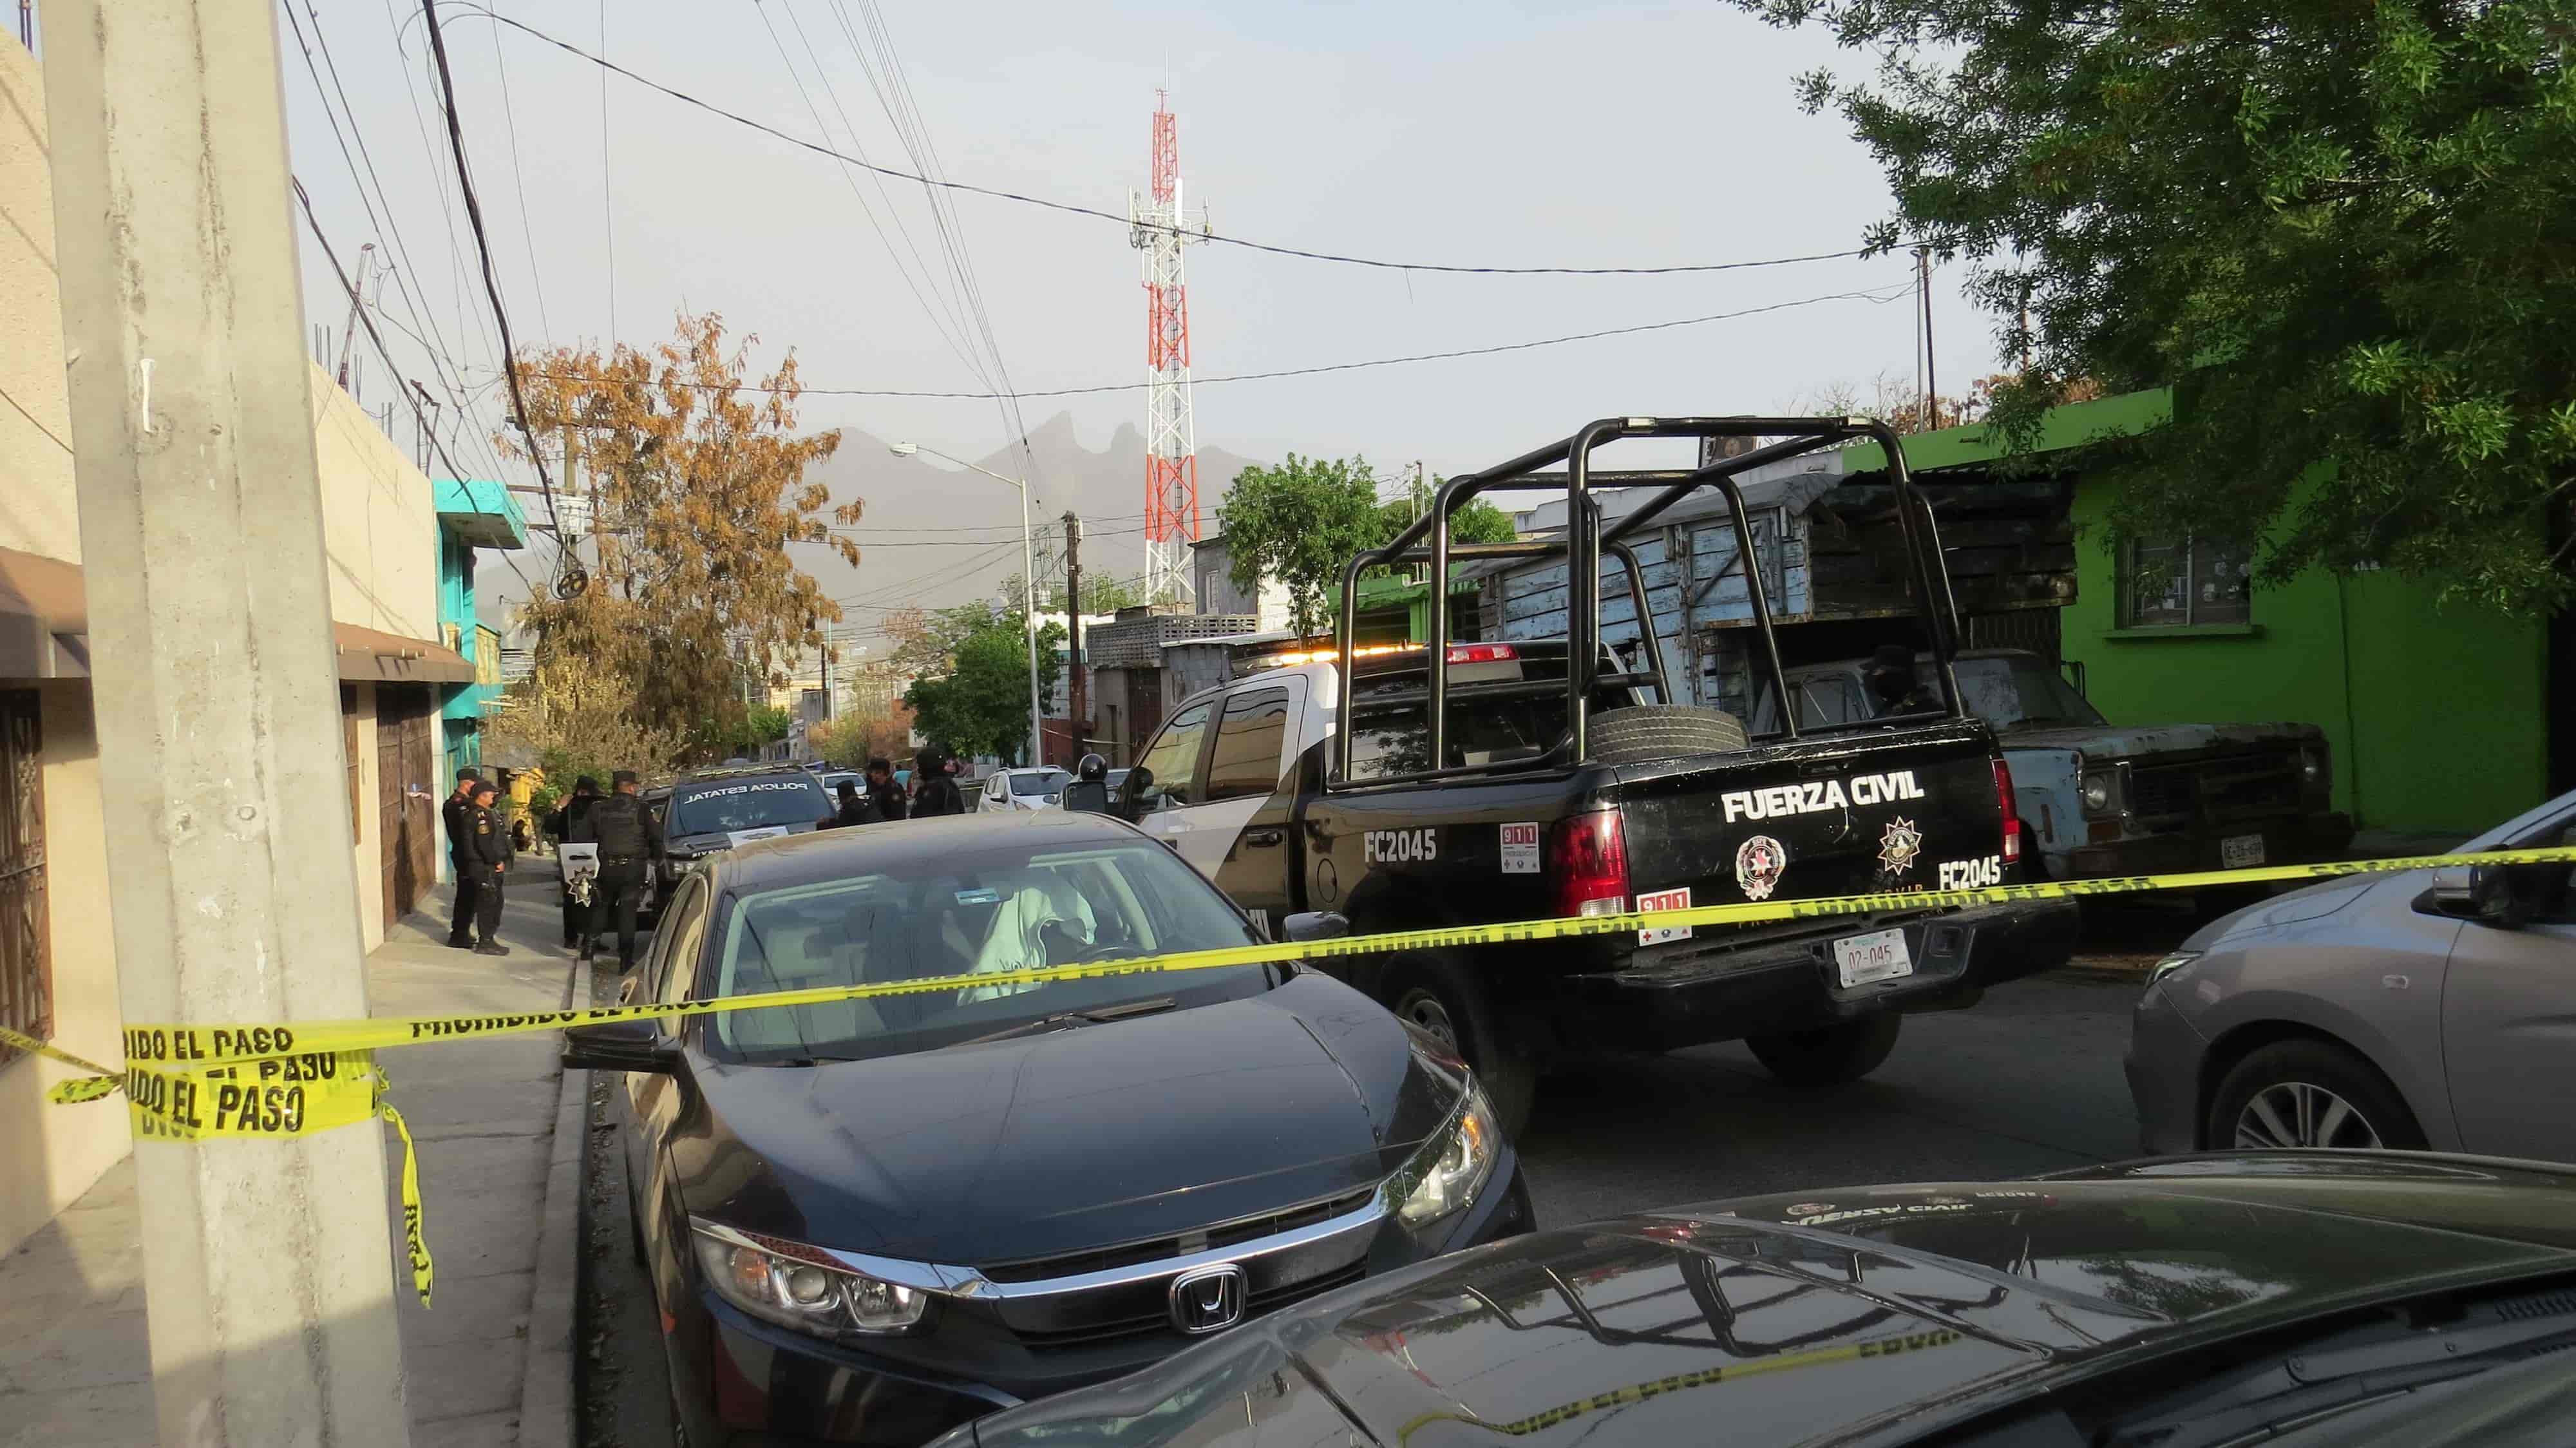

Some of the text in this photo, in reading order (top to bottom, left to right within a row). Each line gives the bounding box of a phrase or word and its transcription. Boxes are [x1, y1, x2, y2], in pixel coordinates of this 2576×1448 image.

[1721, 770, 1925, 823] FUERZA CIVIL
[1363, 828, 1437, 862] FC2045
[1504, 828, 1534, 843] 911
[1938, 855, 2001, 891] FC2045
[1643, 894, 1684, 913] 911
[174, 1030, 205, 1060] EL
[213, 1027, 294, 1058] PASO
[173, 1079, 202, 1129] EL
[216, 1084, 305, 1132] PASO
